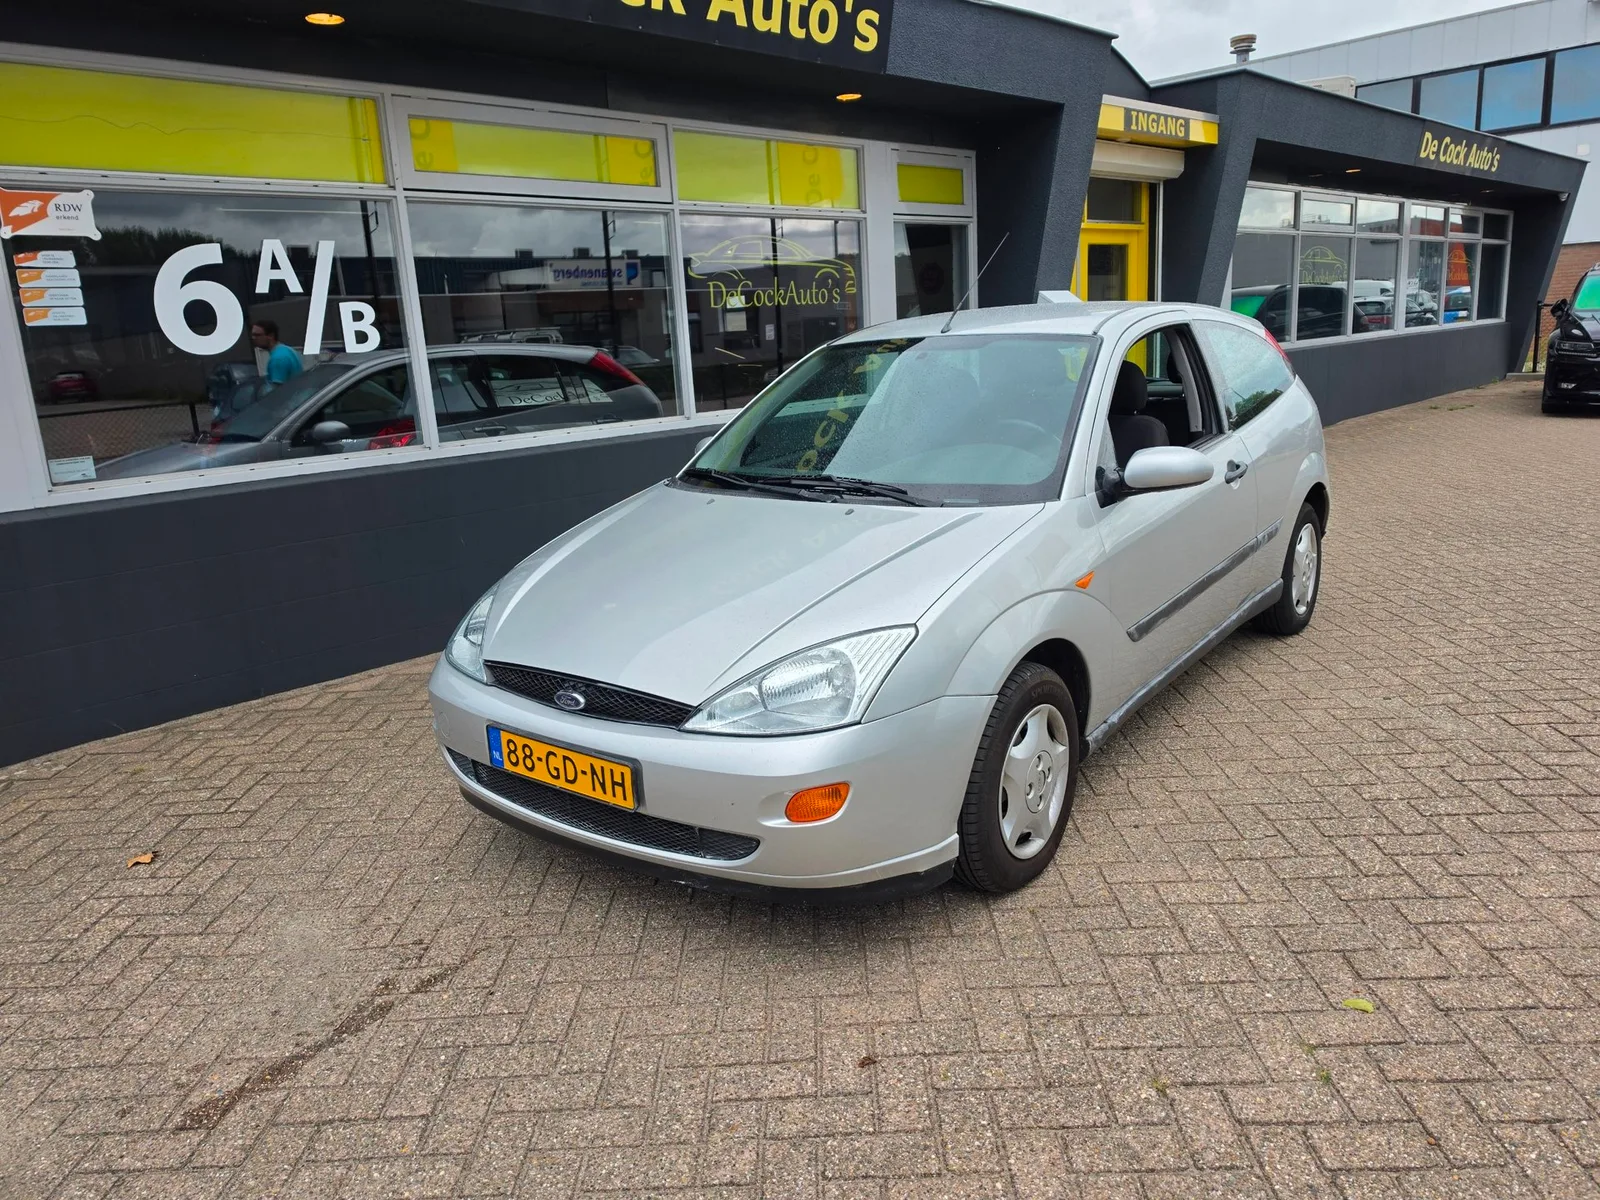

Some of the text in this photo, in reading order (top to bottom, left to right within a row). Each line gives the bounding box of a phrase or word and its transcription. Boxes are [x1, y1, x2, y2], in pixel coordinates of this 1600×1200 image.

[706, 0, 881, 52] Auto's
[1130, 111, 1185, 137] INGANG
[1420, 131, 1500, 172] De Cock Auto's
[55, 203, 82, 212] RDW
[706, 276, 841, 309] DeCockAuto's
[493, 750, 502, 761] NL
[506, 738, 627, 802] 88-GD-NH
